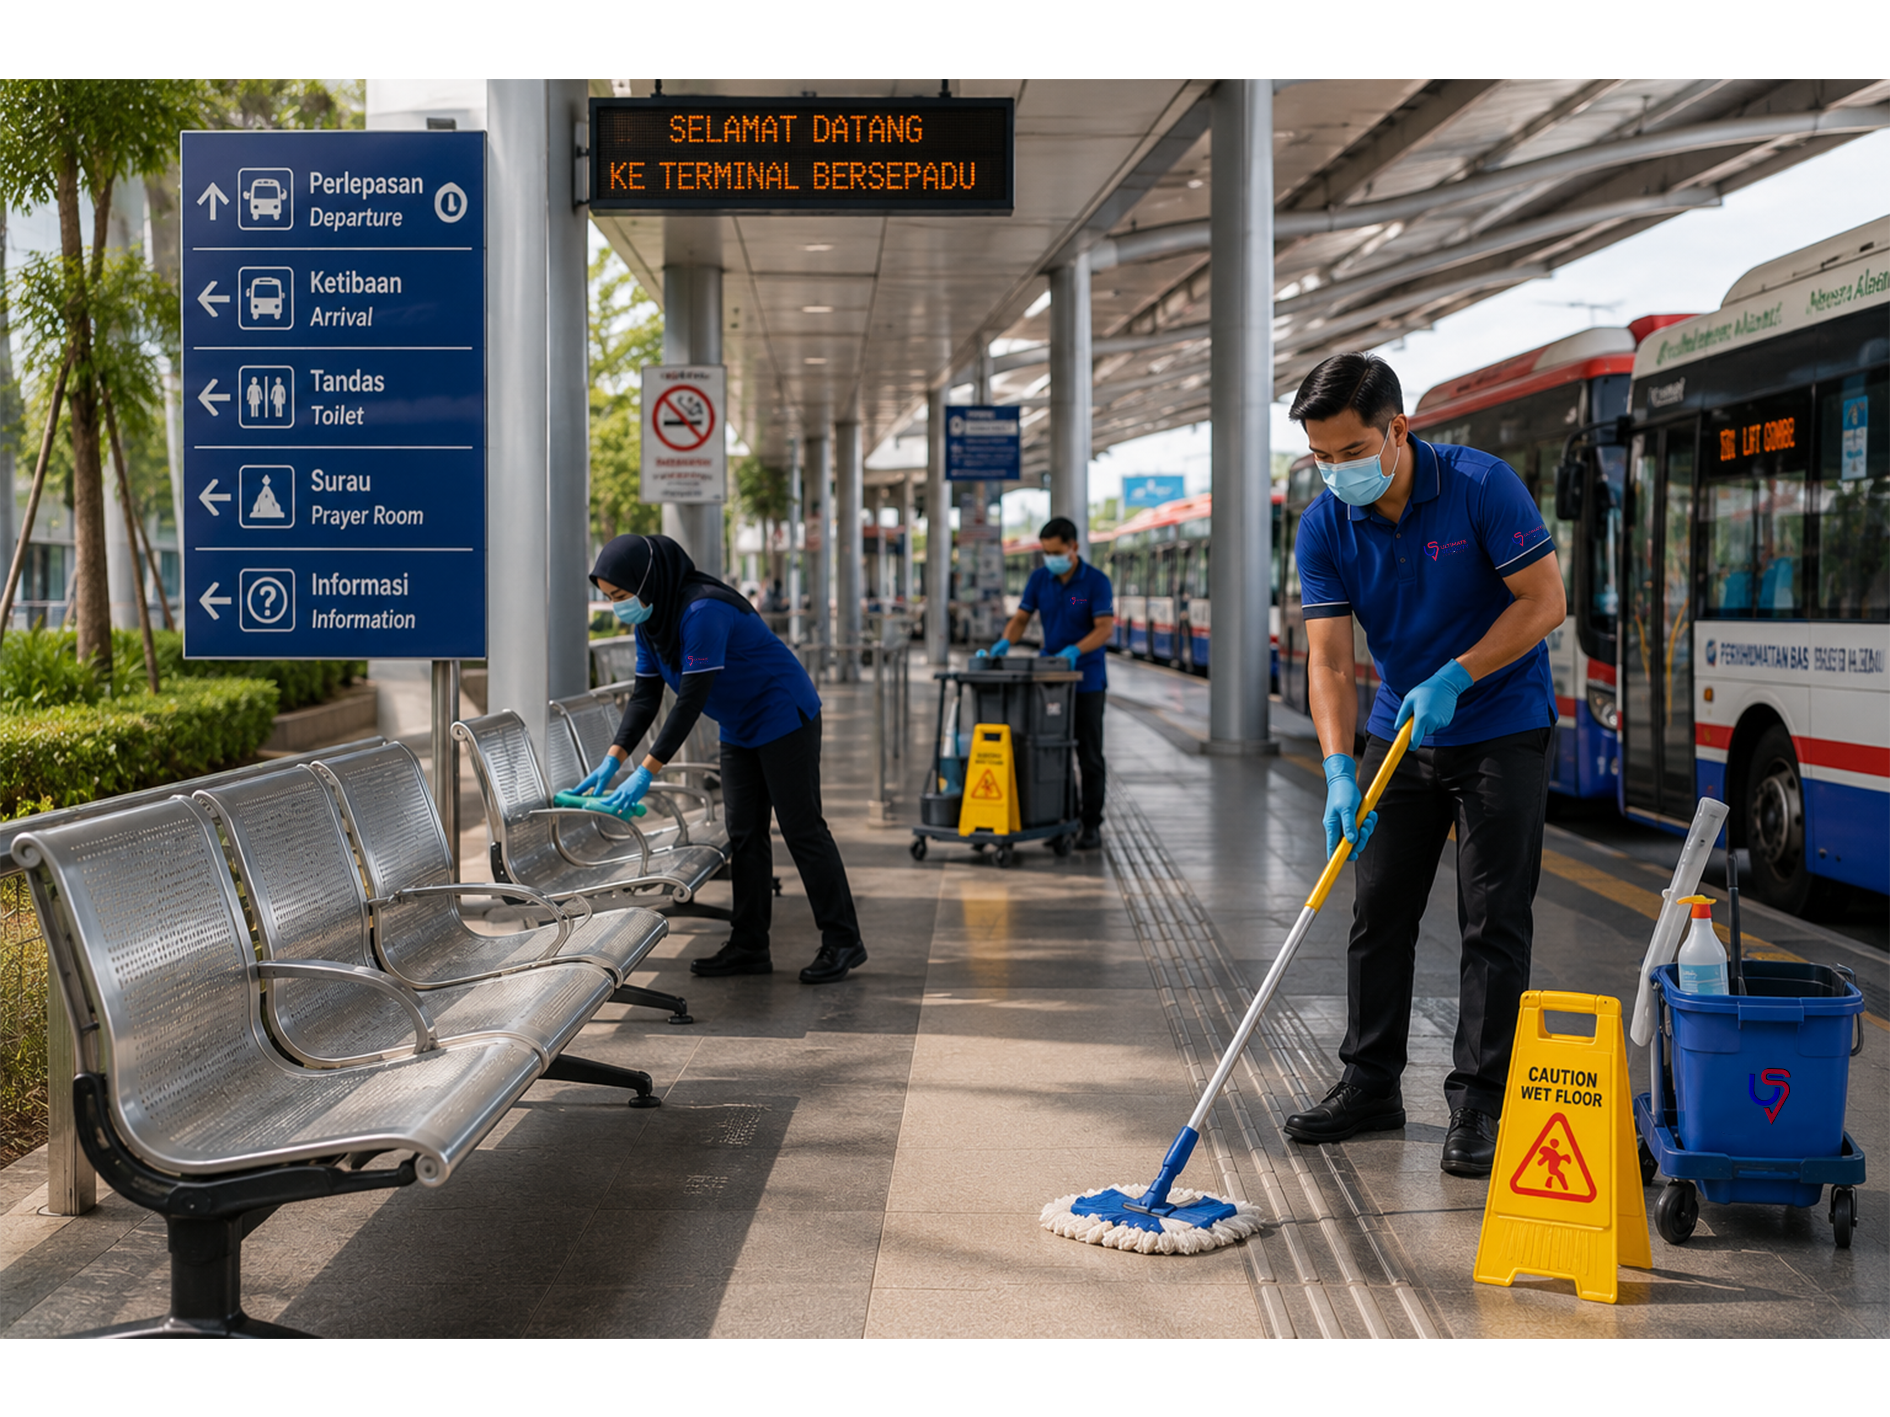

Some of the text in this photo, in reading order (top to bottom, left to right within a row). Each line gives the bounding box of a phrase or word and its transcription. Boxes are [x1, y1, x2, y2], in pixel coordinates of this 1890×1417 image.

[669, 114, 923, 144] SELAMAT DATANG
[309, 170, 423, 200] Perlepasan
[610, 161, 976, 190] KE TERMINAL BERSEPADU
[309, 207, 403, 232] Departure
[310, 270, 402, 294] Ketibaan
[309, 306, 373, 327] Arrival
[310, 368, 385, 392] Tandas
[311, 404, 365, 425] Toilet
[311, 468, 371, 492] Surau
[311, 505, 424, 530] Prayer Room
[312, 572, 408, 596] Informasi
[312, 608, 416, 629] Information
[1528, 1066, 1598, 1088] CAUTION
[1521, 1085, 1603, 1108] WET FLOOR
